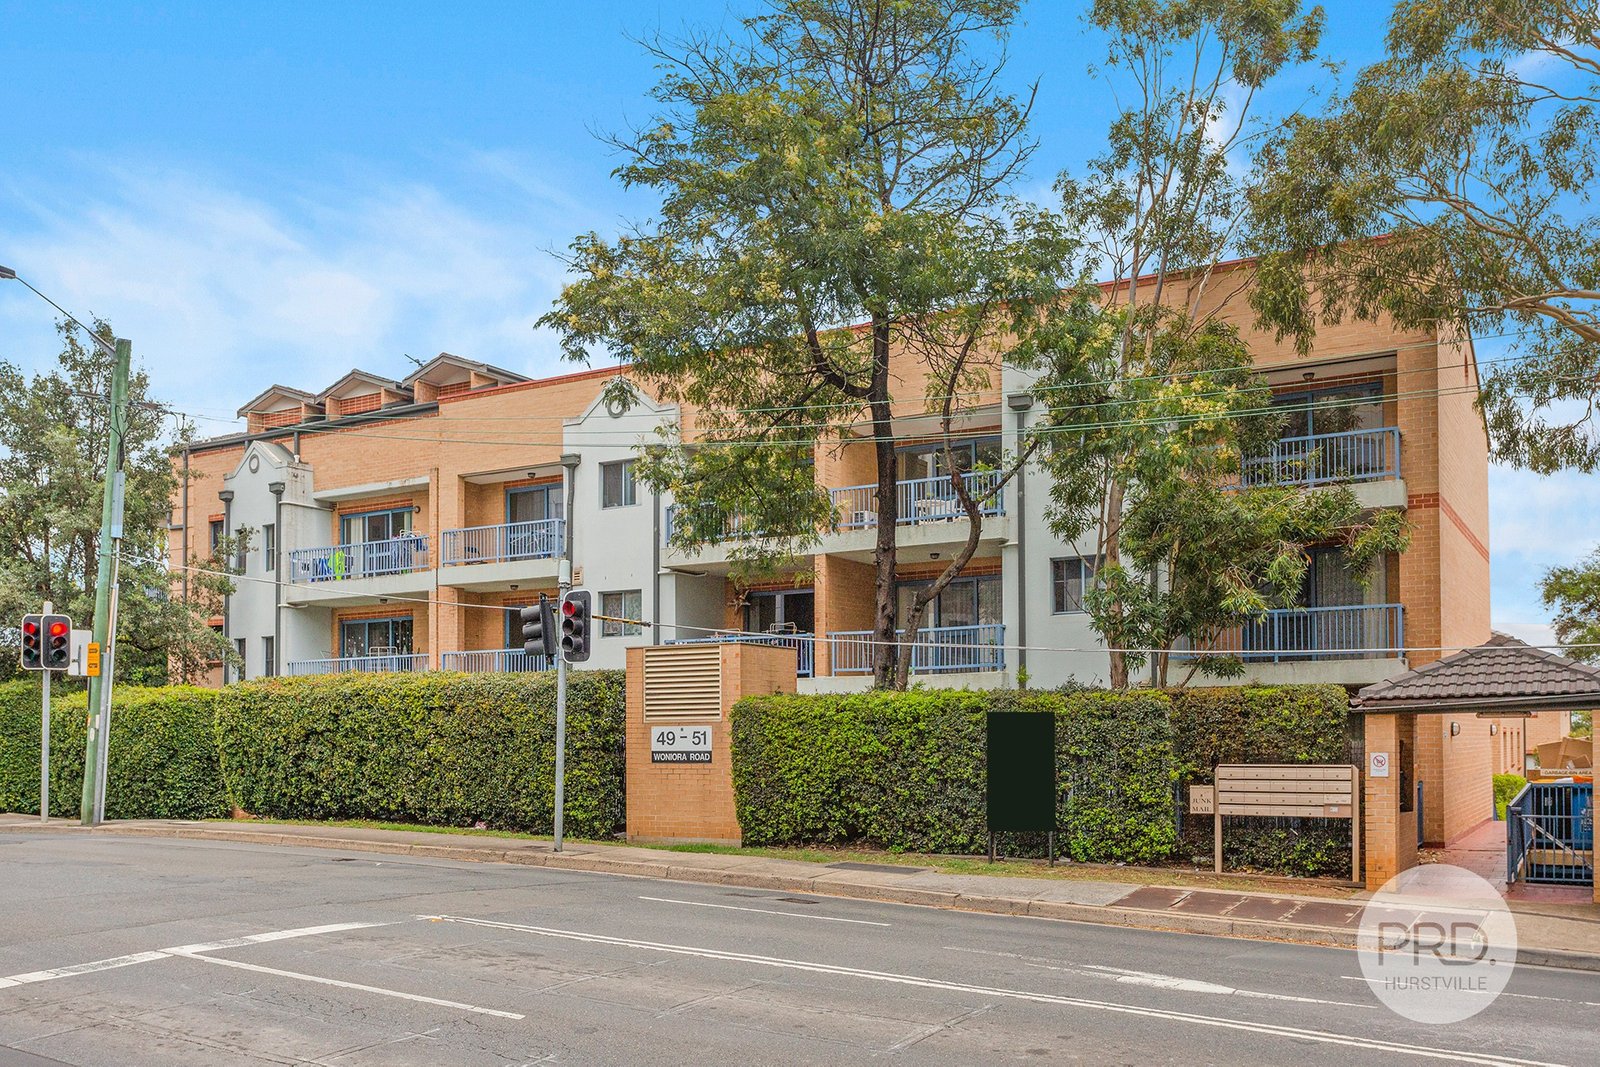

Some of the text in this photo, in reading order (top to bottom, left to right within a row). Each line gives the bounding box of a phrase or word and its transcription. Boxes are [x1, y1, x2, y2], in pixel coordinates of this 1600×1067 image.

[656, 731, 676, 746] 49
[692, 731, 707, 746] 51
[653, 753, 710, 761] WONIORA ROAD
